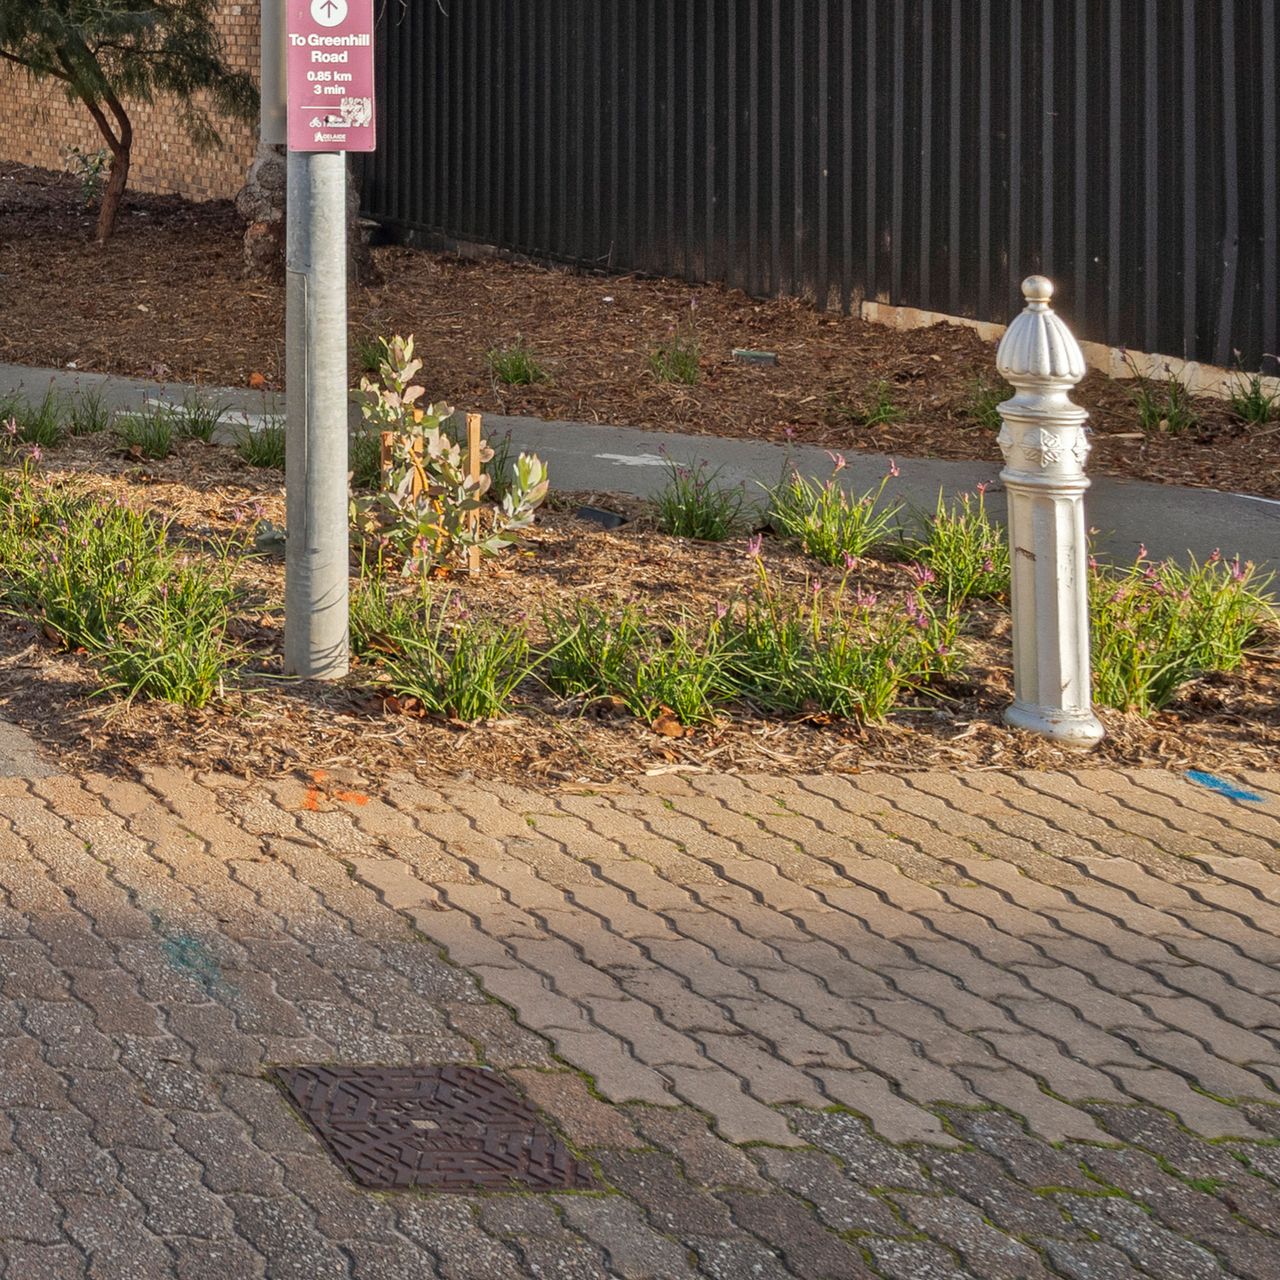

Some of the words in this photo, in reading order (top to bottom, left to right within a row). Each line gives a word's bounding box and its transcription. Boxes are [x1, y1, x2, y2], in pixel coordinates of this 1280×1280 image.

[288, 33, 306, 46] To
[307, 33, 370, 46] Greenhill
[311, 50, 348, 63] Road
[306, 71, 332, 82] 0.85
[333, 71, 352, 82] km
[313, 84, 322, 95] 3
[324, 84, 346, 95] min
